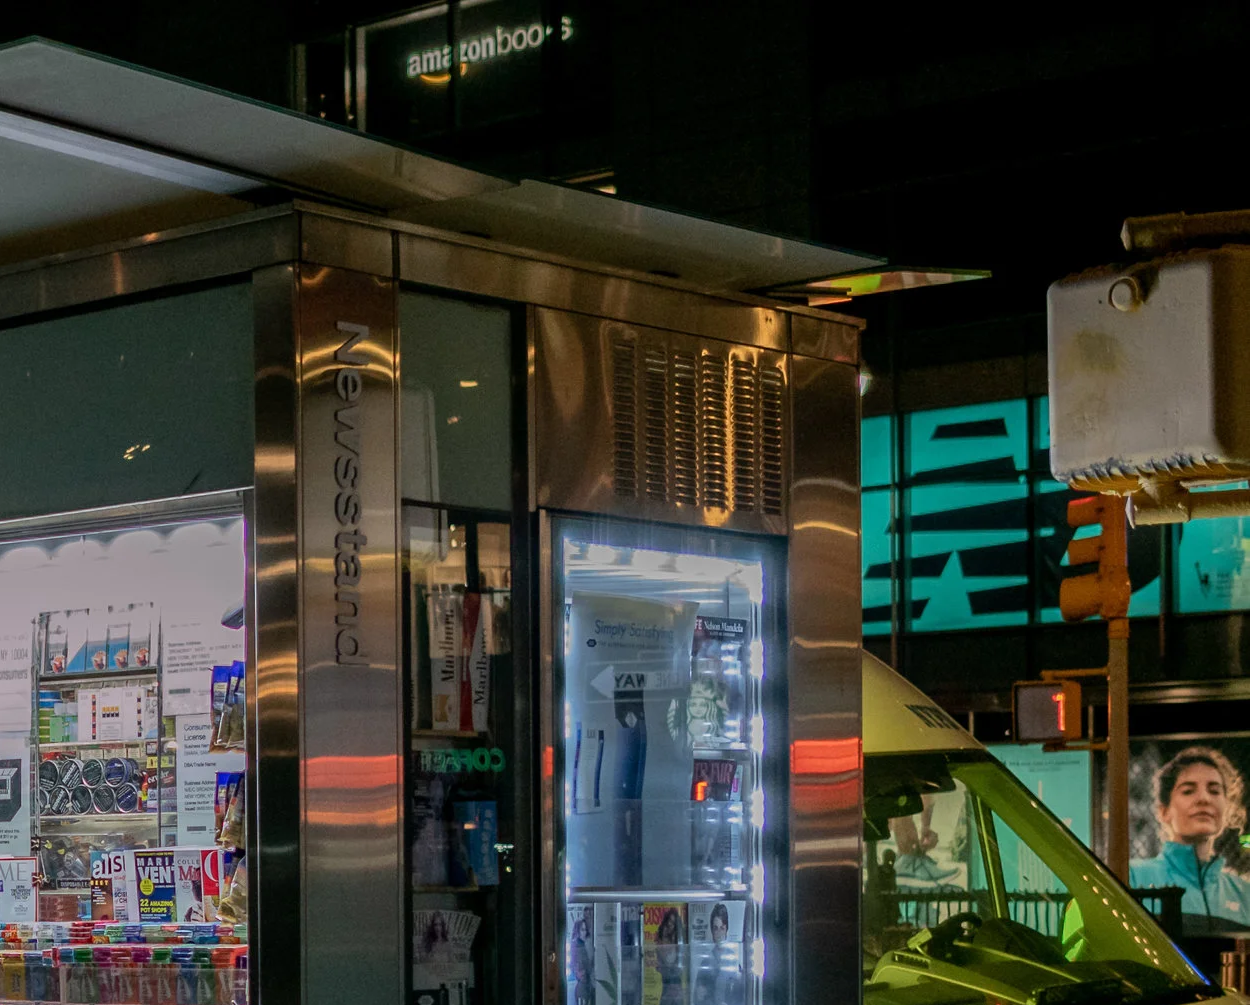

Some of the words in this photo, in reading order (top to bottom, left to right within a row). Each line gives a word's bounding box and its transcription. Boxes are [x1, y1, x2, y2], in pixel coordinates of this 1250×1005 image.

[333, 320, 369, 666] Newsstand
[595, 619, 626, 638] Simply
[629, 623, 674, 642] Satisfying
[140, 899, 149, 907] 22
